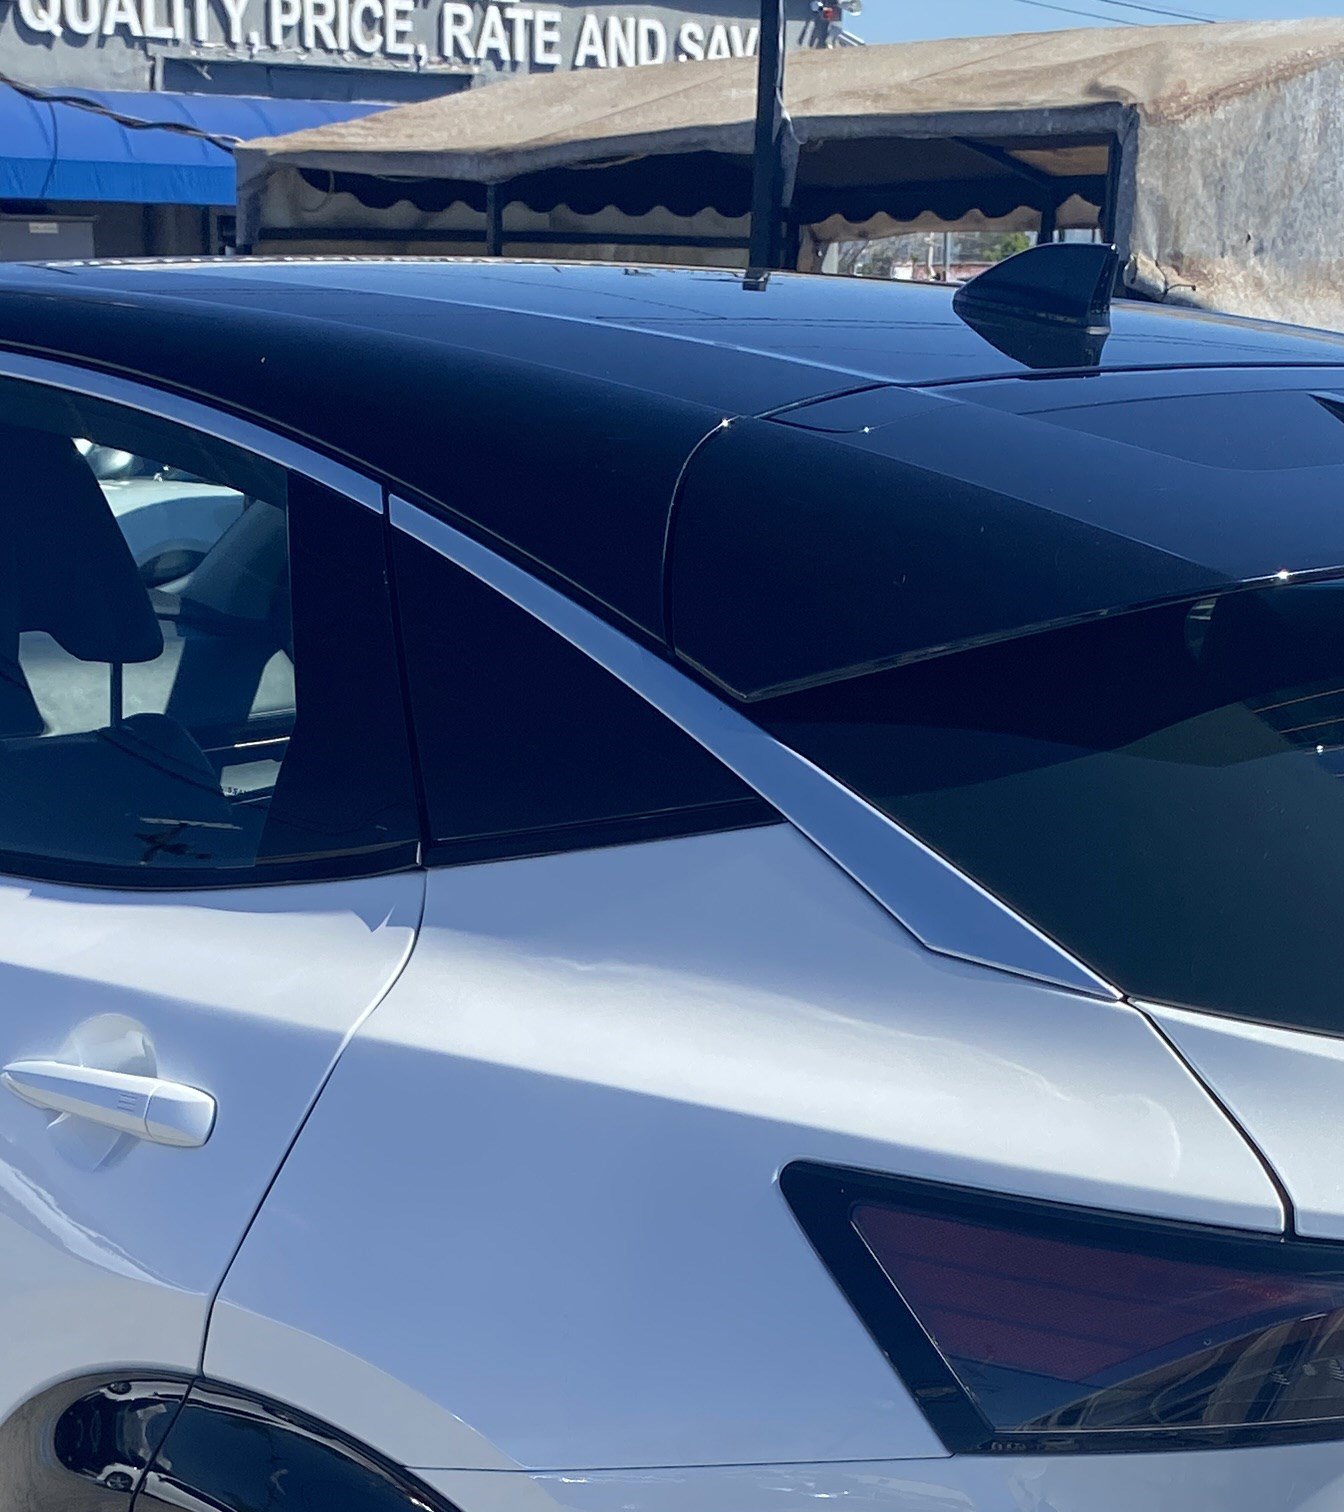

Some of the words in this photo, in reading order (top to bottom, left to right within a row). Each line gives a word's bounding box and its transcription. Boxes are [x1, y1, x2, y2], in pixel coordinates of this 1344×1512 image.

[18, 0, 260, 51] QUALITY,
[271, 0, 427, 65] PRICE,
[443, 2, 562, 65] RATE
[574, 13, 666, 68] AND
[677, 22, 758, 62] SAV
